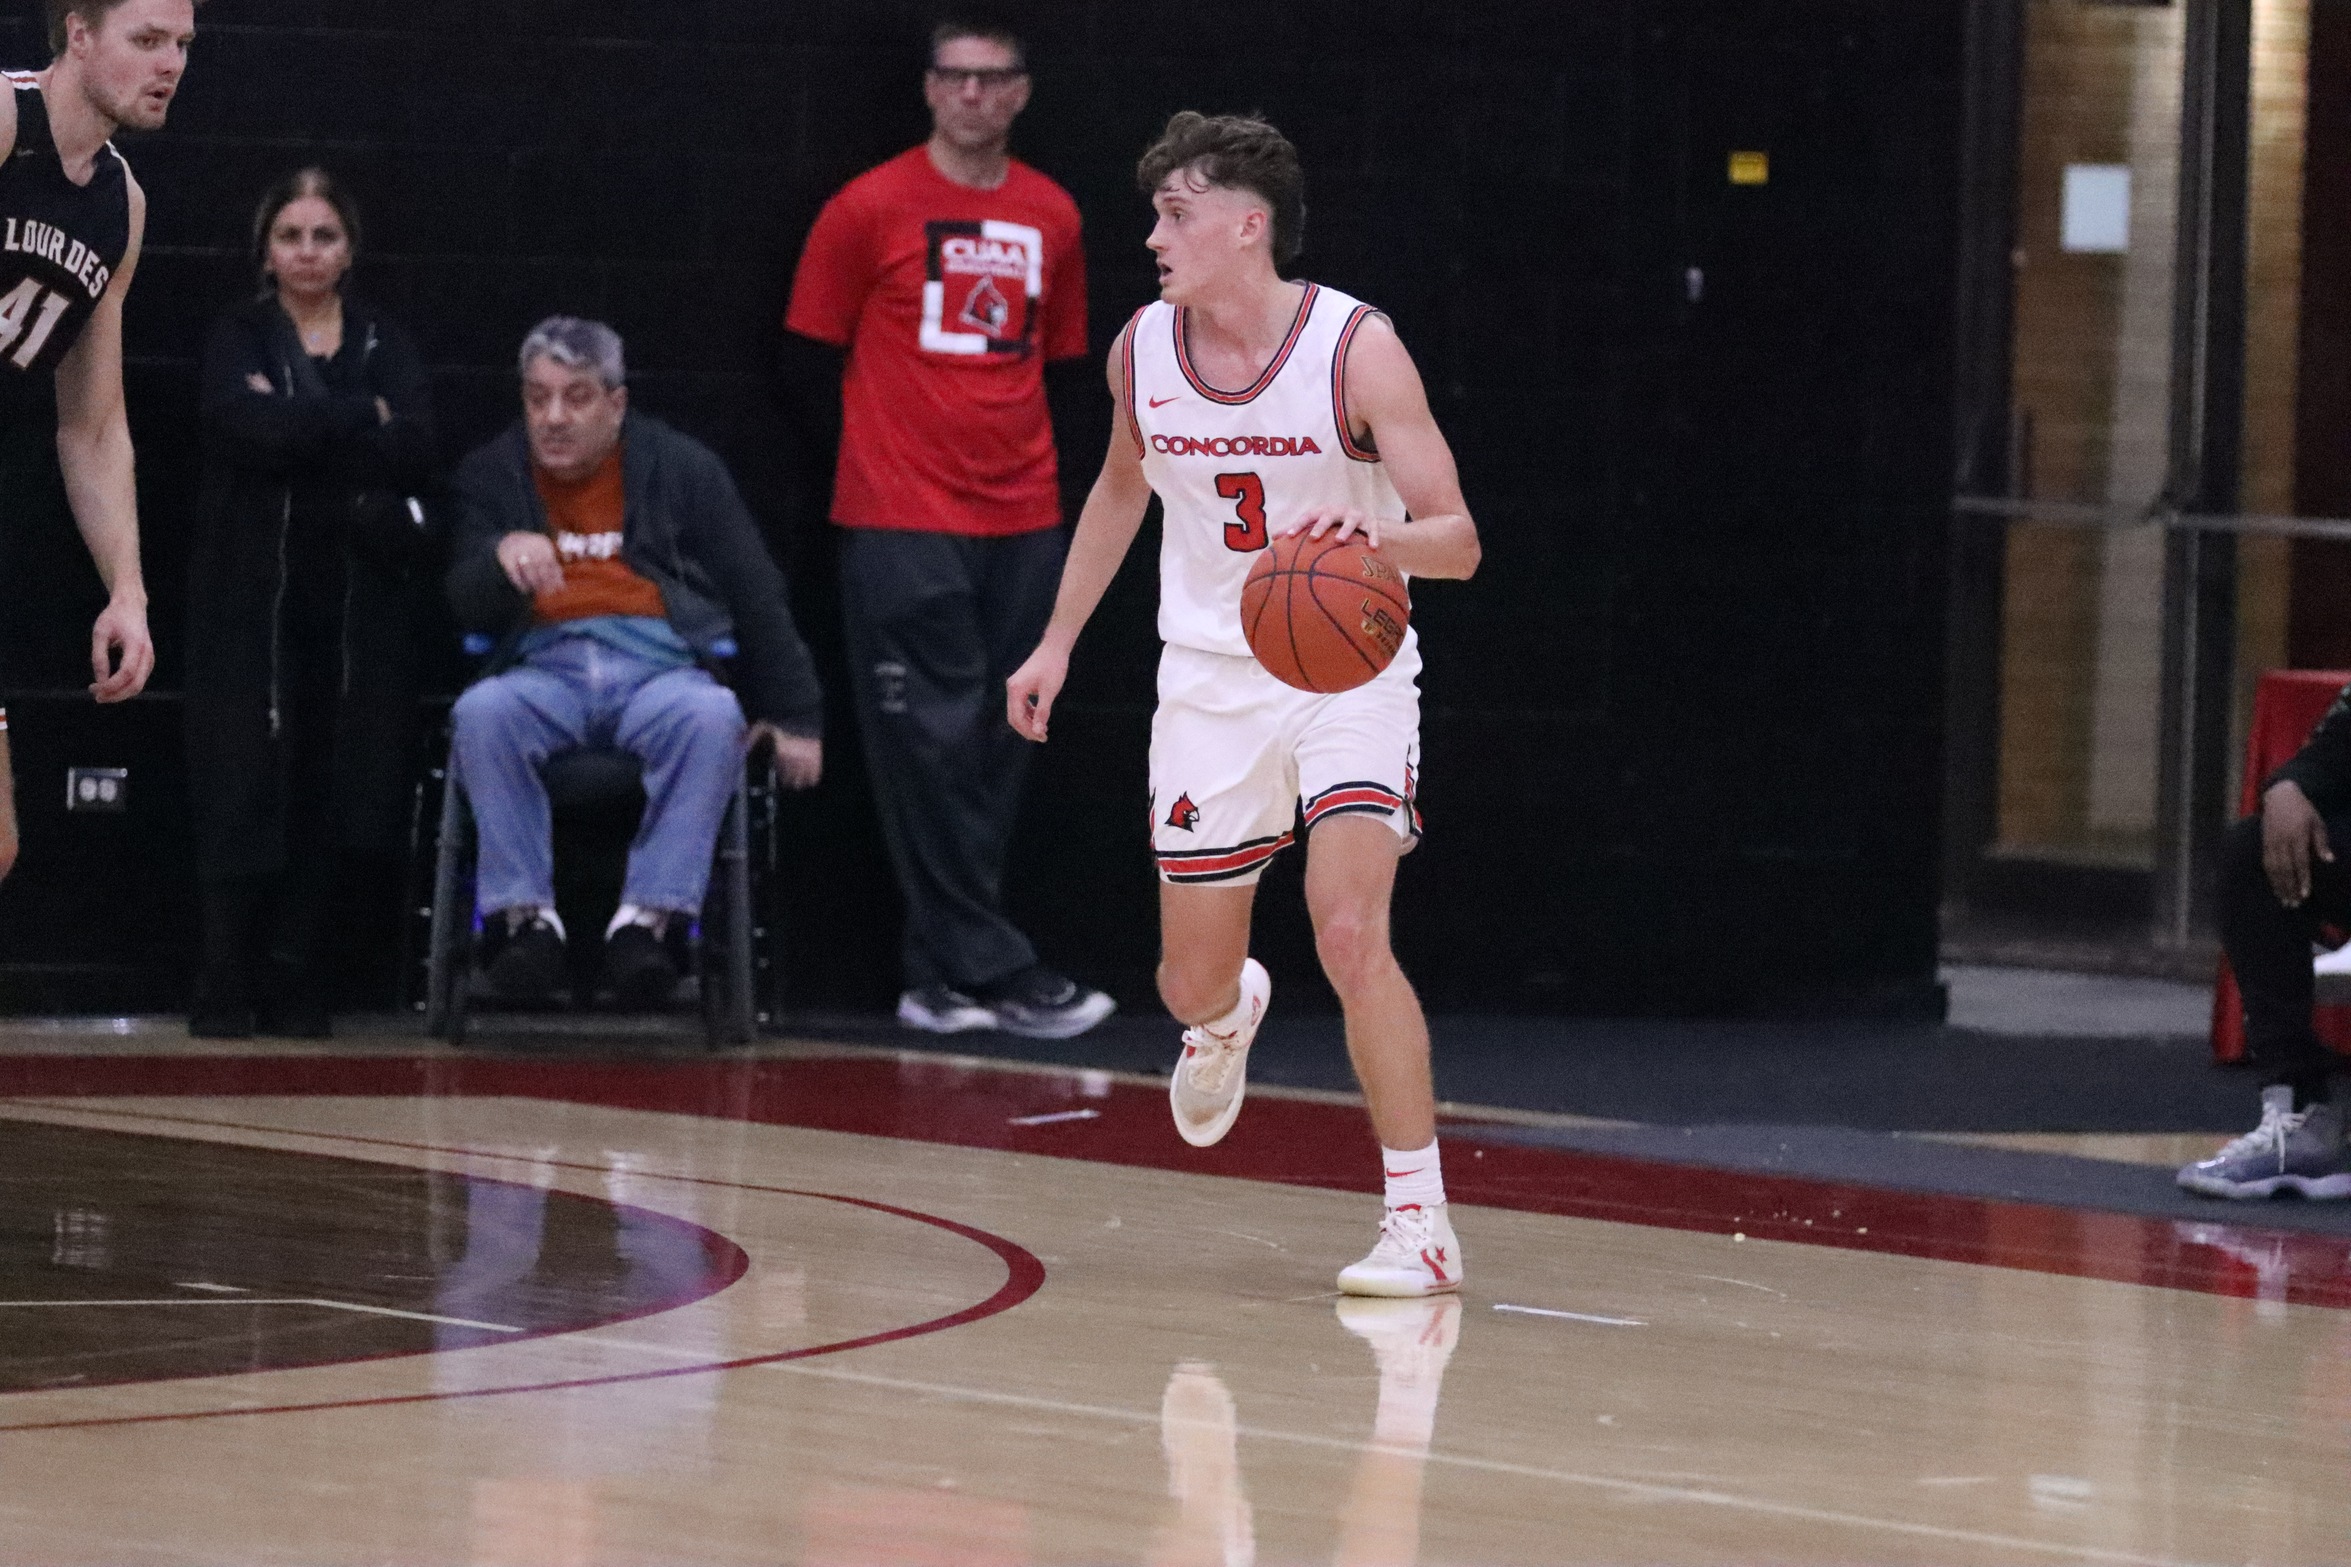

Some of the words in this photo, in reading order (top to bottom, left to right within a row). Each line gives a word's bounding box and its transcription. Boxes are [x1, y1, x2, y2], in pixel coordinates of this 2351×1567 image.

[5, 217, 109, 298] LOURDES
[0, 276, 69, 368] 41
[1150, 434, 1322, 457] CONCORDIA
[1214, 471, 1269, 552] 3
